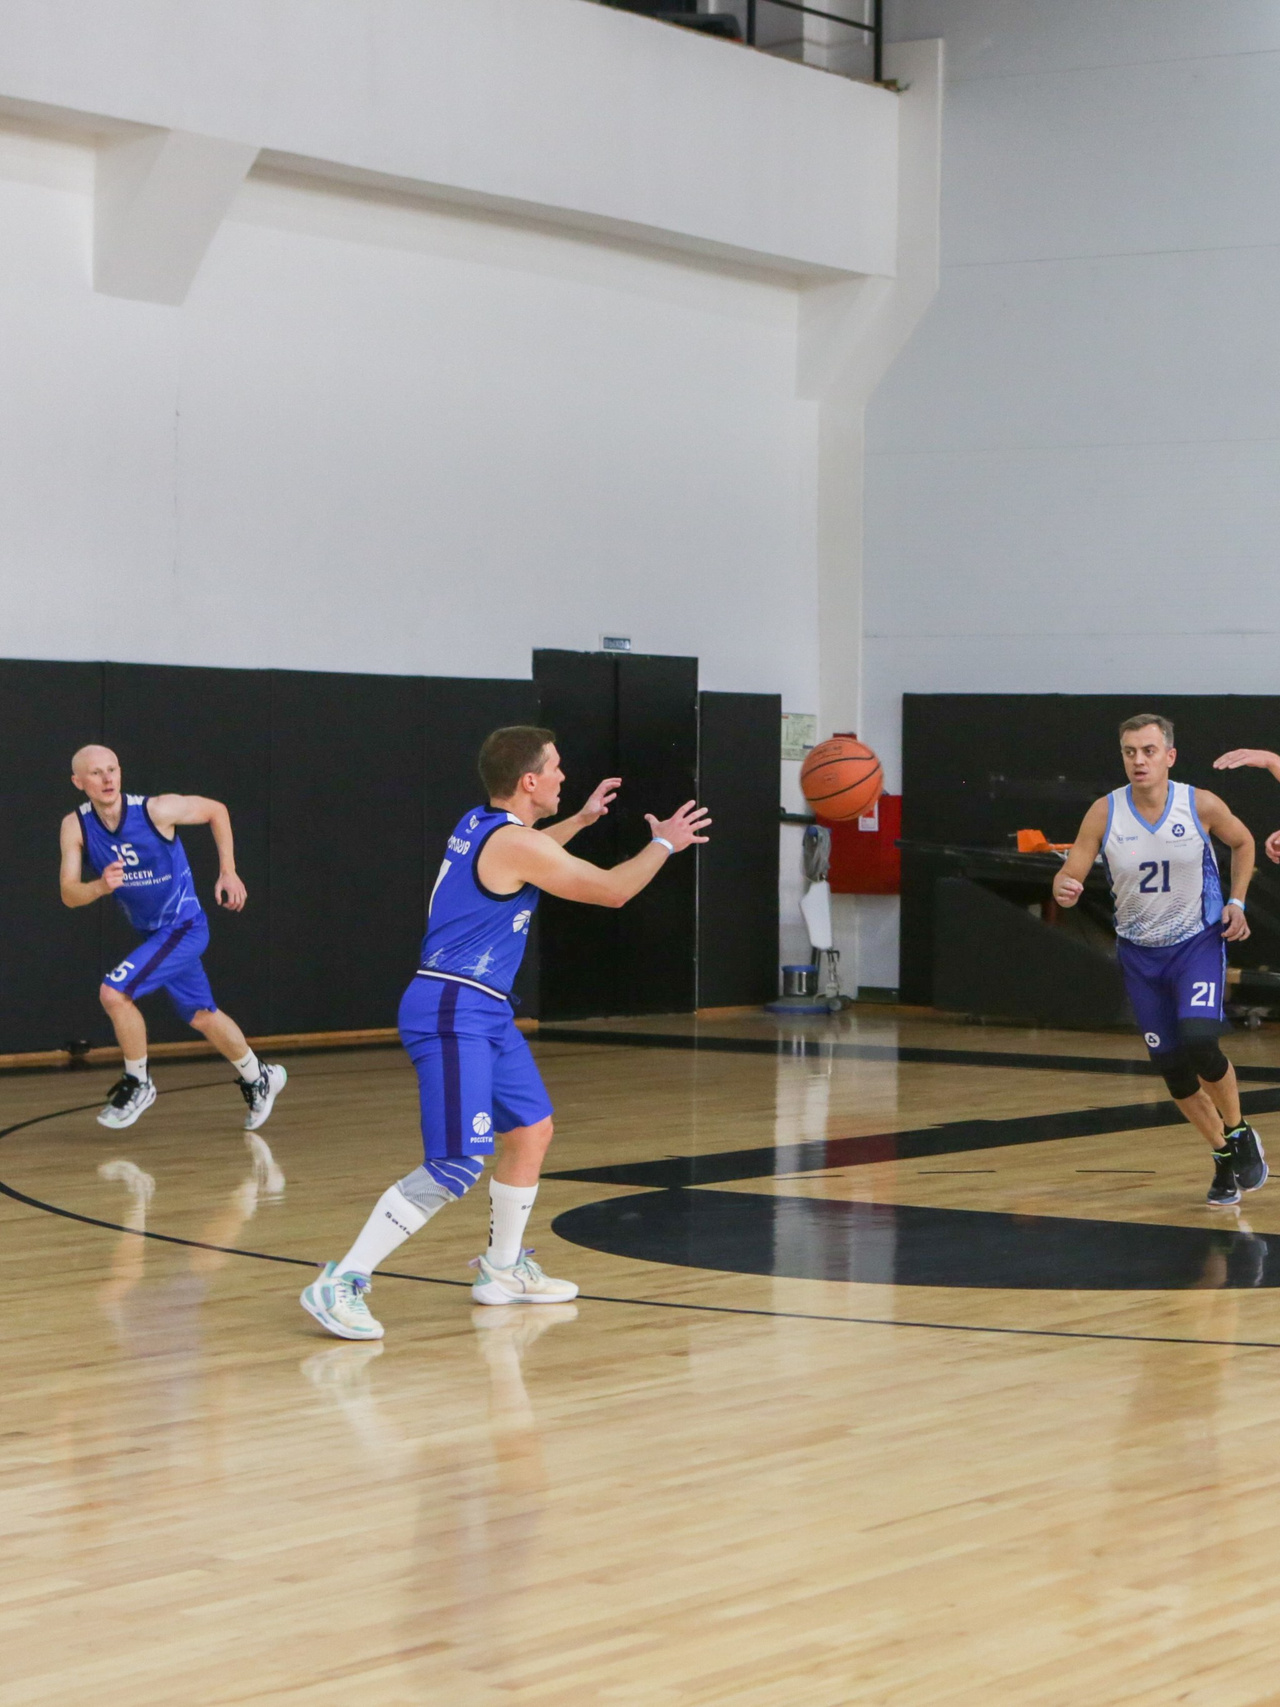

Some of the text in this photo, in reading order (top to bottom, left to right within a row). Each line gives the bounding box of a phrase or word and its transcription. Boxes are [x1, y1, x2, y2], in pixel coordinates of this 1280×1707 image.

[123, 870, 153, 880] ОССЕТИ
[1139, 860, 1171, 893] 21
[106, 960, 135, 982] 5
[1190, 981, 1216, 1007] 21
